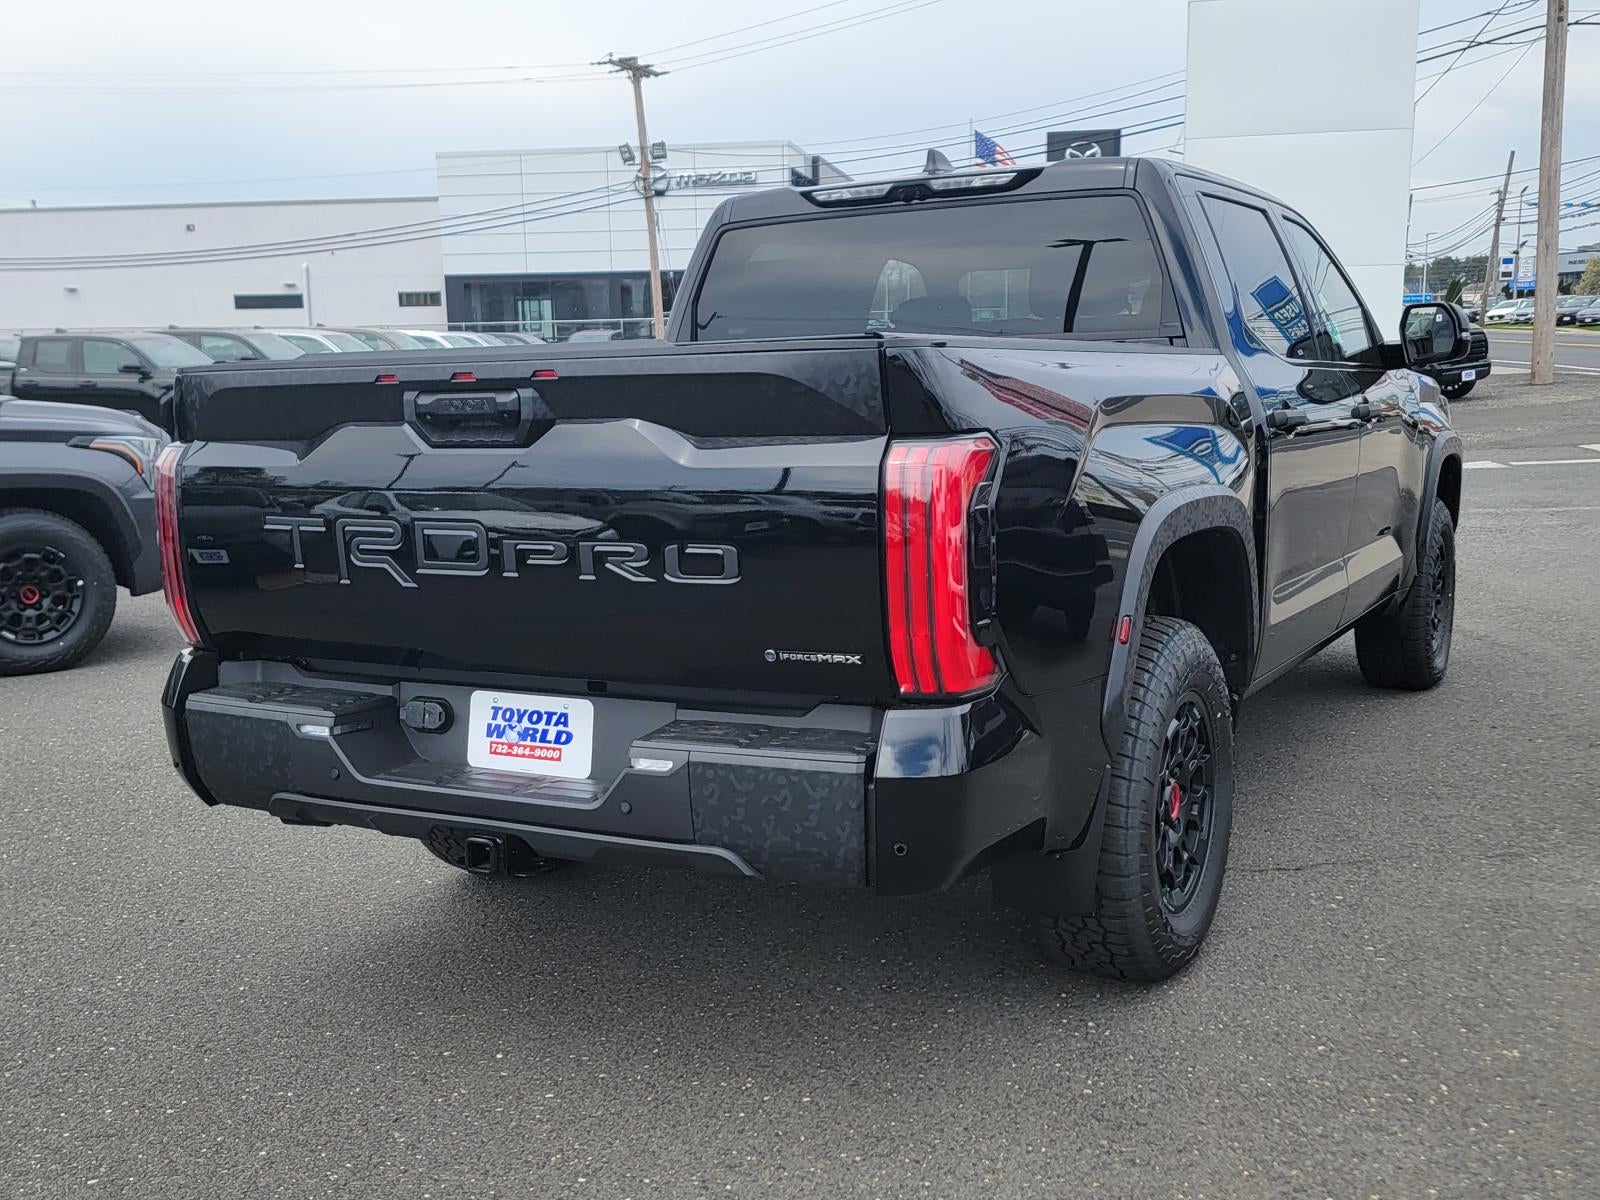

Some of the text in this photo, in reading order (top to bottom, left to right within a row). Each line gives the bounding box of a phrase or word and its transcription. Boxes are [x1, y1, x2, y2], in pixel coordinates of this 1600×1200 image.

[441, 399, 488, 411] TOYOTA
[490, 705, 569, 728] TOYOTA
[490, 744, 560, 759] 732-364-9000
